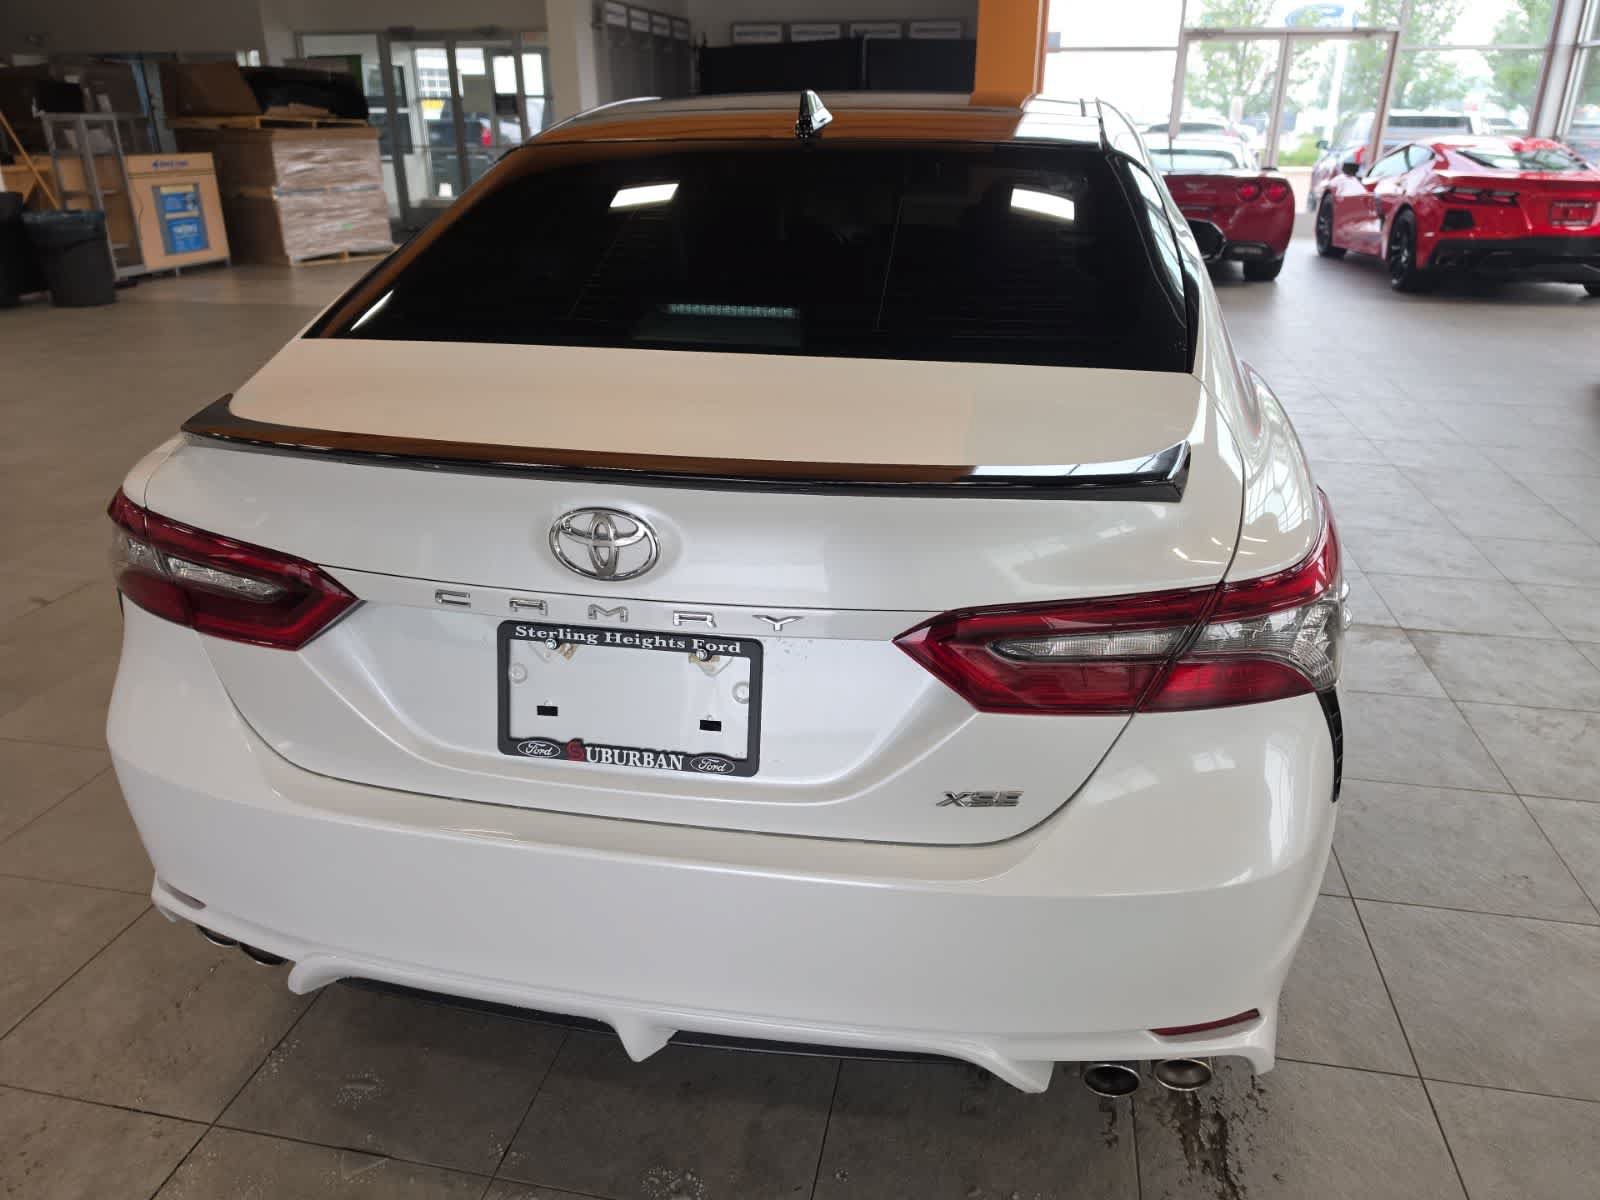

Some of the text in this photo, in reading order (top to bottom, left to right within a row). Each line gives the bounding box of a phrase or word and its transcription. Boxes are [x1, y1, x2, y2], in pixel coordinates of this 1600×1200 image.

[434, 588, 804, 632] CAMRY
[514, 626, 742, 654] Sterling Heights Ford
[524, 739, 728, 773] Ford SUBURBAN Ford
